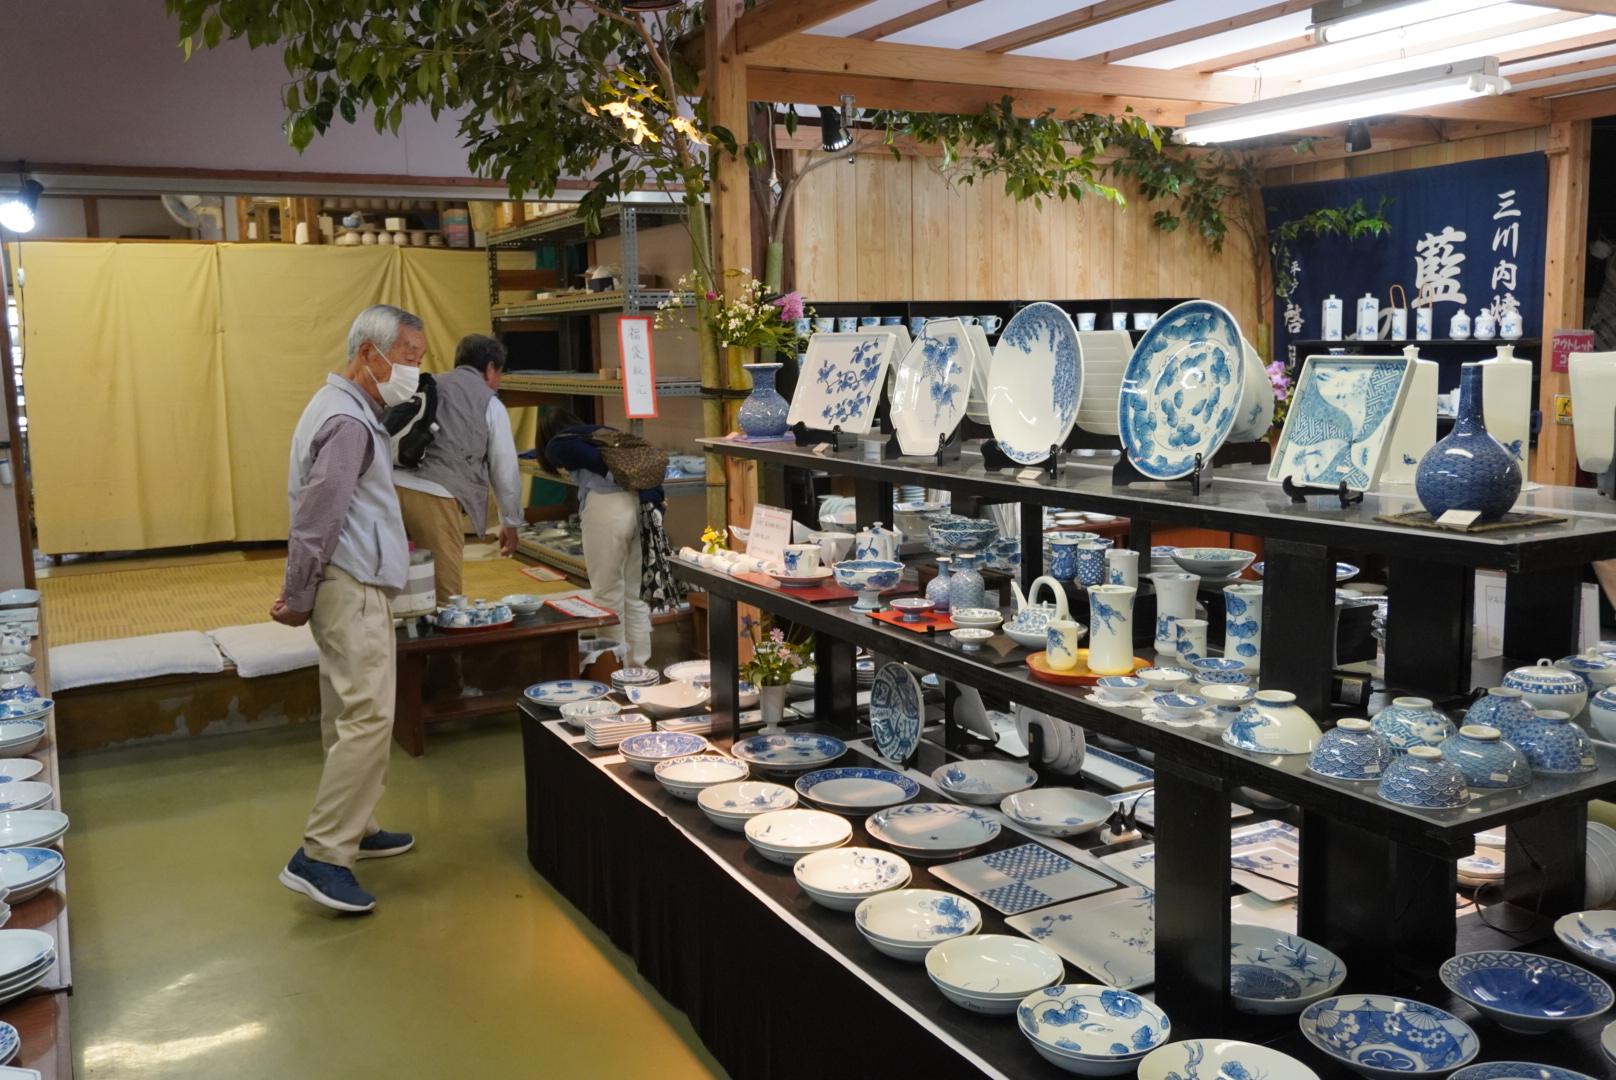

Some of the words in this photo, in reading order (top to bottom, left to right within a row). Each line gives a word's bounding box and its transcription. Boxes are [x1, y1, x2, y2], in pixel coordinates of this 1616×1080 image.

[1410, 226, 1468, 310] 藍
[1552, 337, 1593, 352] アウトレット
